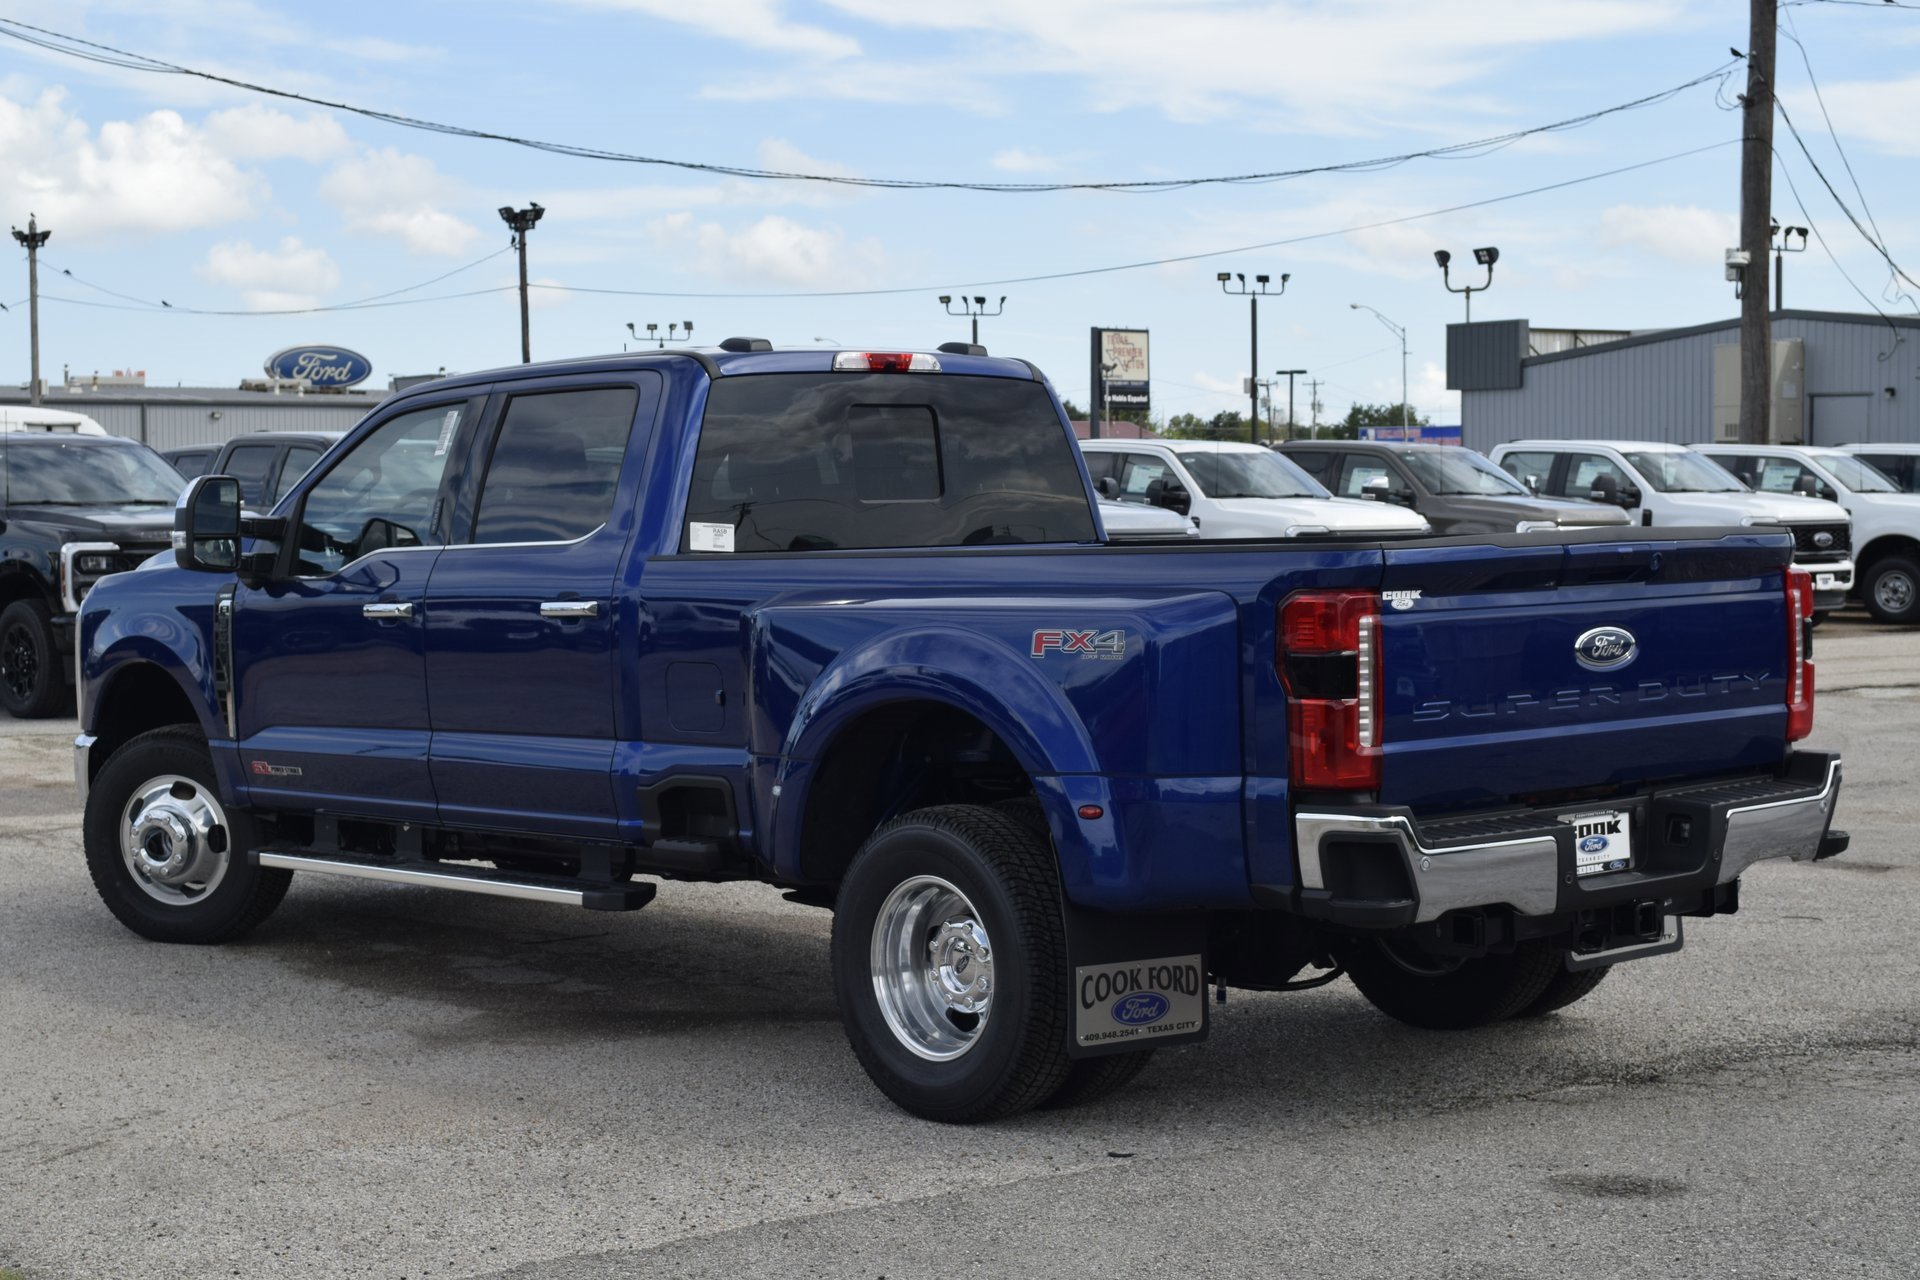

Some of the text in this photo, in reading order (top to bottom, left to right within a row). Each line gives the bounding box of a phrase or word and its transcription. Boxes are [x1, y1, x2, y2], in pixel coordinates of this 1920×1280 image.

[292, 352, 352, 380] Ford
[1382, 590, 1422, 600] COOK
[1030, 629, 1125, 658] FX4
[1592, 635, 1623, 658] Ford
[1412, 672, 1770, 722] SUPER DUTY
[1575, 820, 1622, 839] OOK
[1584, 838, 1603, 852] Ford
[1081, 964, 1199, 1010] COOK FORD
[1122, 998, 1159, 1020] Ford
[1083, 1020, 1196, 1041] 409.948.2541 TEXAS CITY
